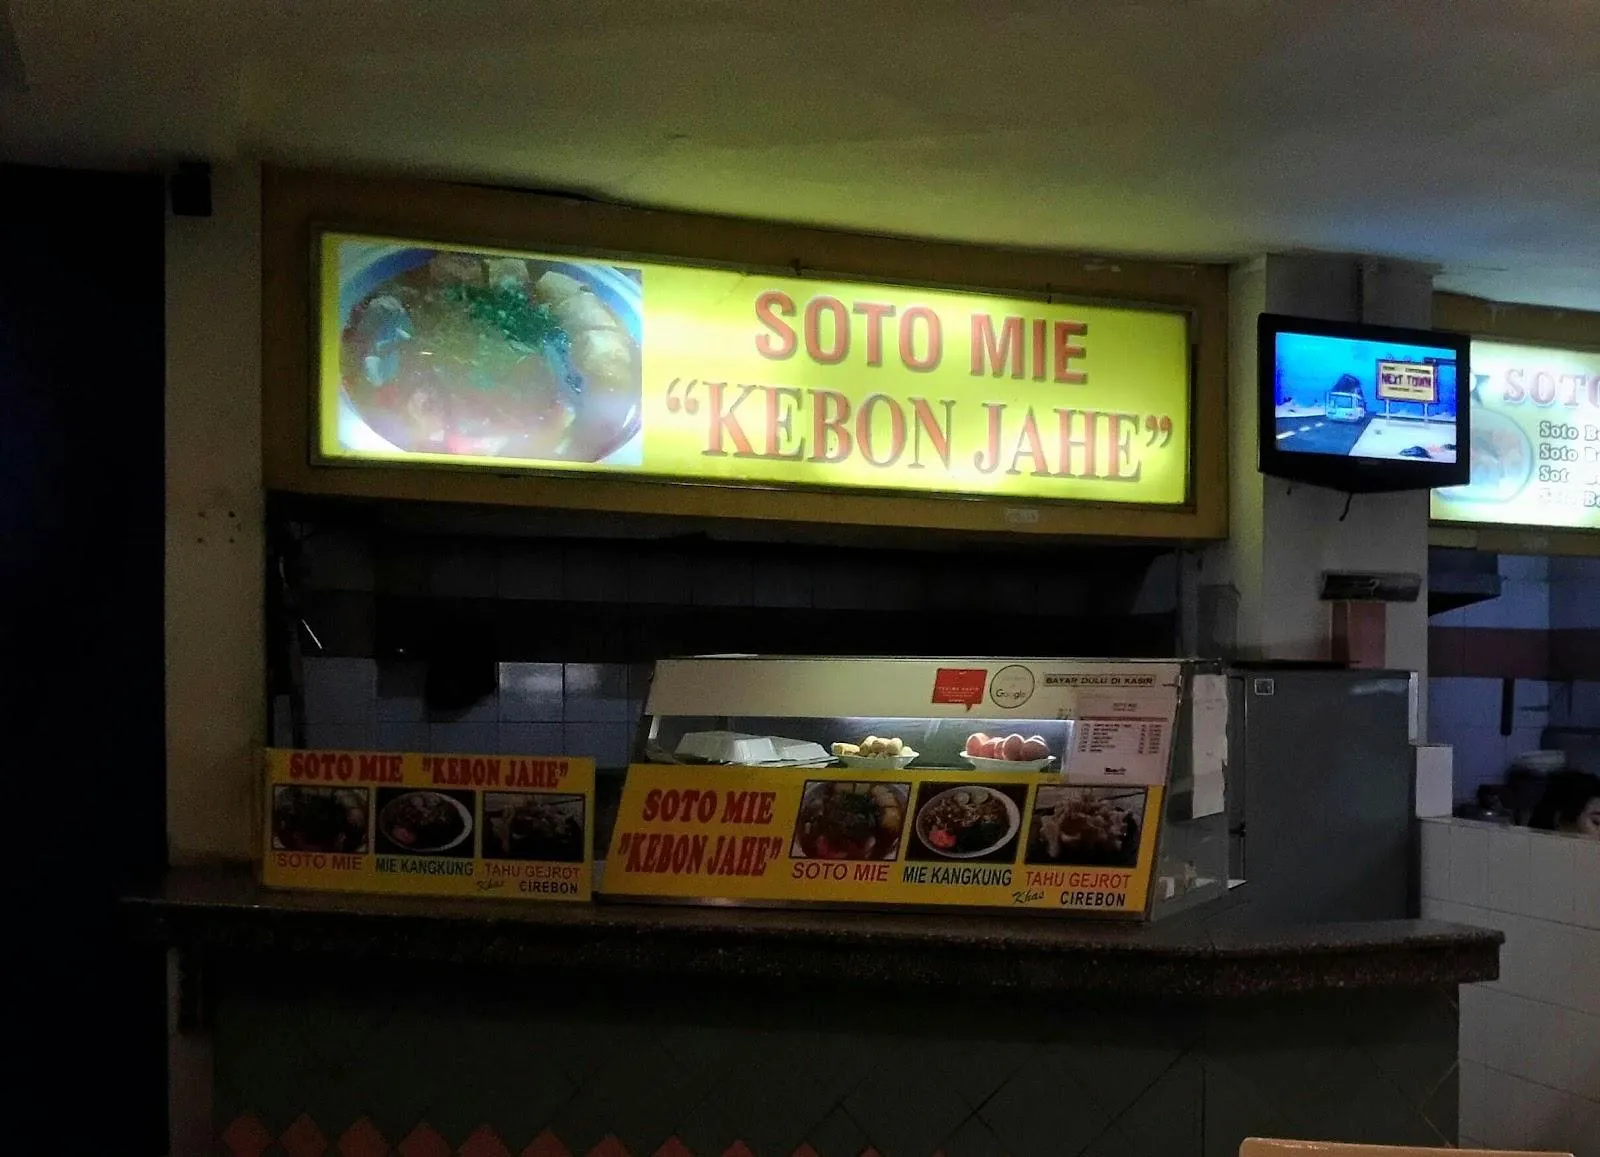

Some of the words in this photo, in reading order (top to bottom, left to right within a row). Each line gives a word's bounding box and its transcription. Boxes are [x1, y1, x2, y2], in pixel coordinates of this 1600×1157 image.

[755, 290, 943, 373] SOTO
[970, 313, 1088, 385] MIE
[666, 377, 956, 469] “KEBON
[974, 402, 1173, 482] JAHE”
[1539, 421, 1579, 440] Soto
[1539, 443, 1578, 462] Soto
[289, 754, 354, 781] SOTO
[360, 755, 403, 783] MIE
[643, 789, 718, 823] SOTO
[720, 791, 777, 824] MIE
[276, 853, 327, 869] SOTO
[331, 855, 363, 870] MIE
[375, 858, 396, 873] MIE
[400, 860, 474, 876] KANGKUNG
[483, 863, 520, 878] TAHU
[525, 866, 581, 880] GEJROT
[791, 863, 848, 881] SOTO
[853, 864, 890, 882] MIE
[903, 866, 928, 884] MIE
[930, 868, 1013, 887] KANGKUNG
[1025, 871, 1064, 888] TAHU
[1069, 873, 1132, 889] GEJROT
[519, 881, 579, 894] CIREBON
[1060, 891, 1126, 907] CIREBON
